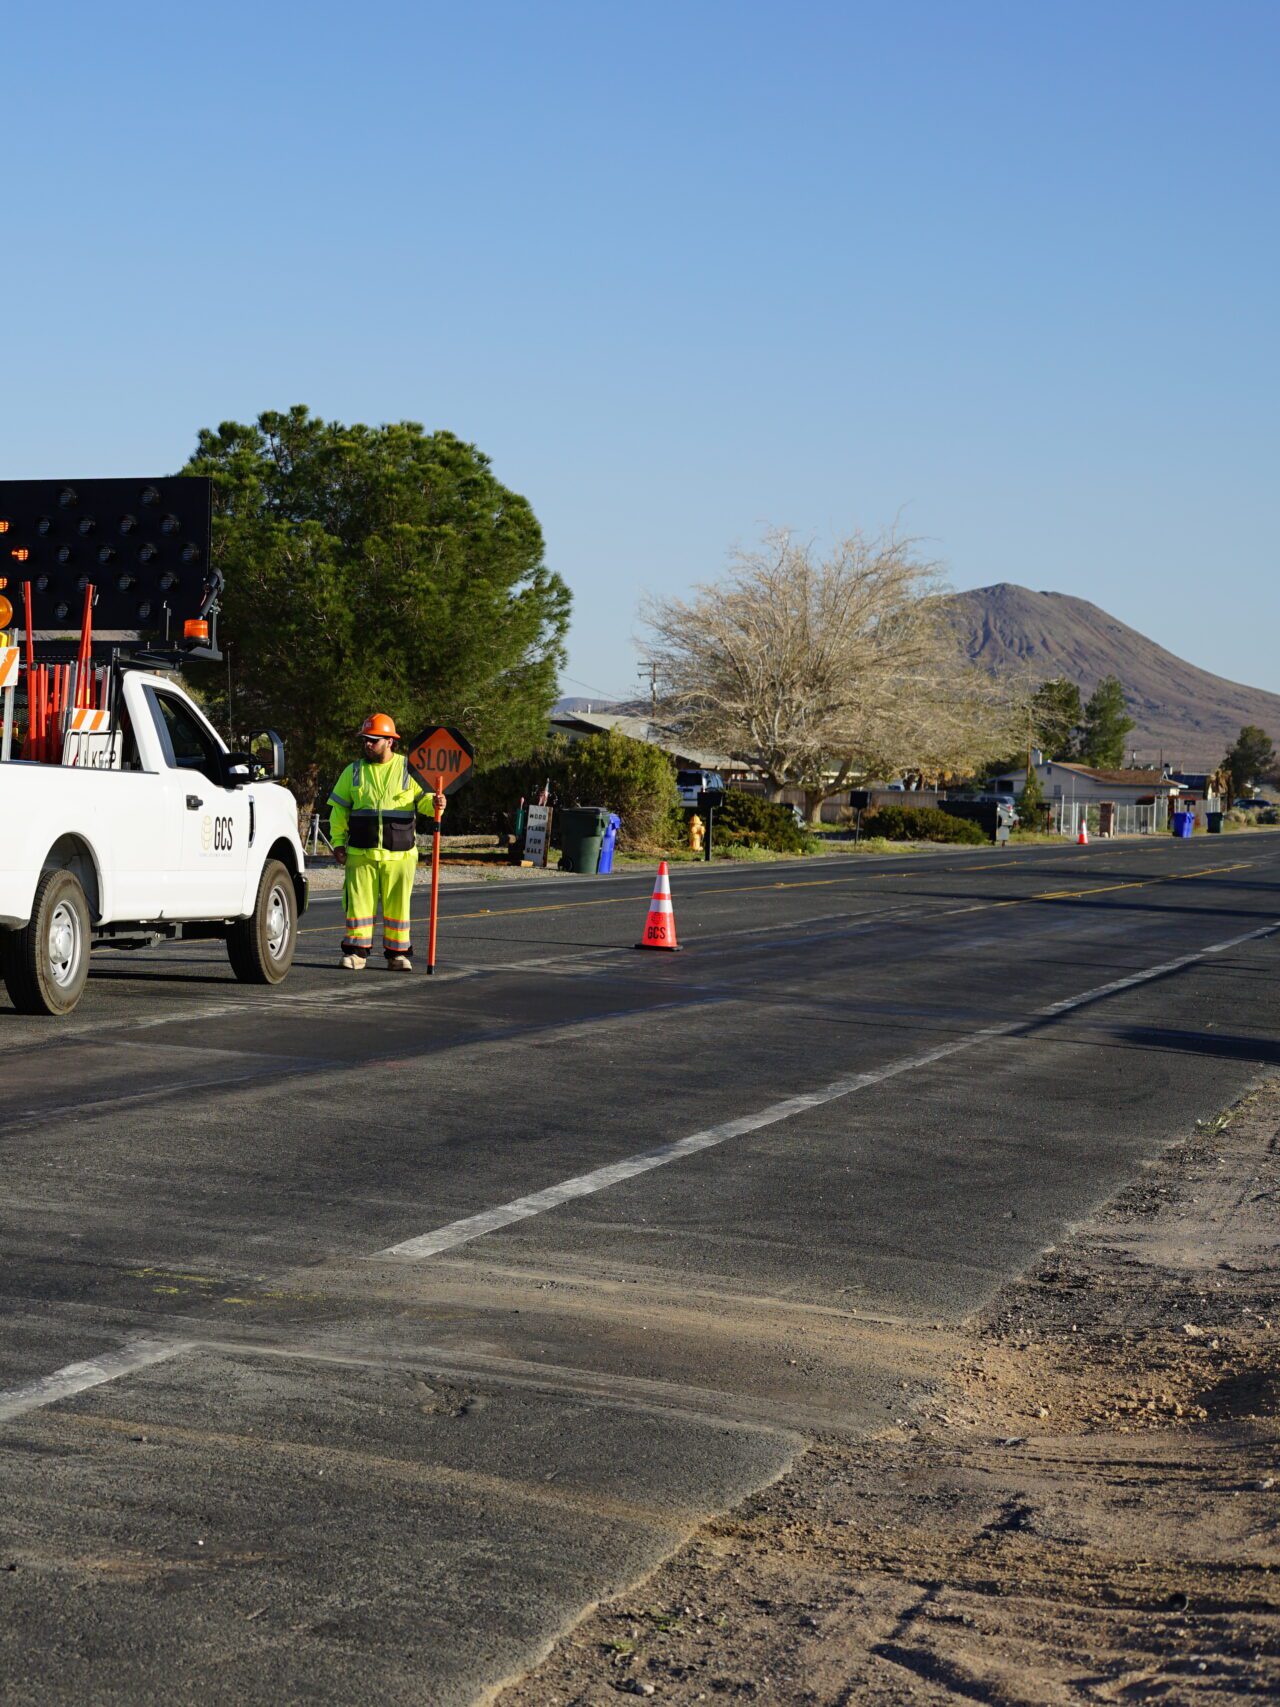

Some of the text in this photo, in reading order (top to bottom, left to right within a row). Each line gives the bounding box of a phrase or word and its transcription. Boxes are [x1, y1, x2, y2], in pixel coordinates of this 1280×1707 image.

[416, 747, 462, 772] SLOW
[214, 816, 233, 850] GCS
[647, 926, 666, 939] GCS
